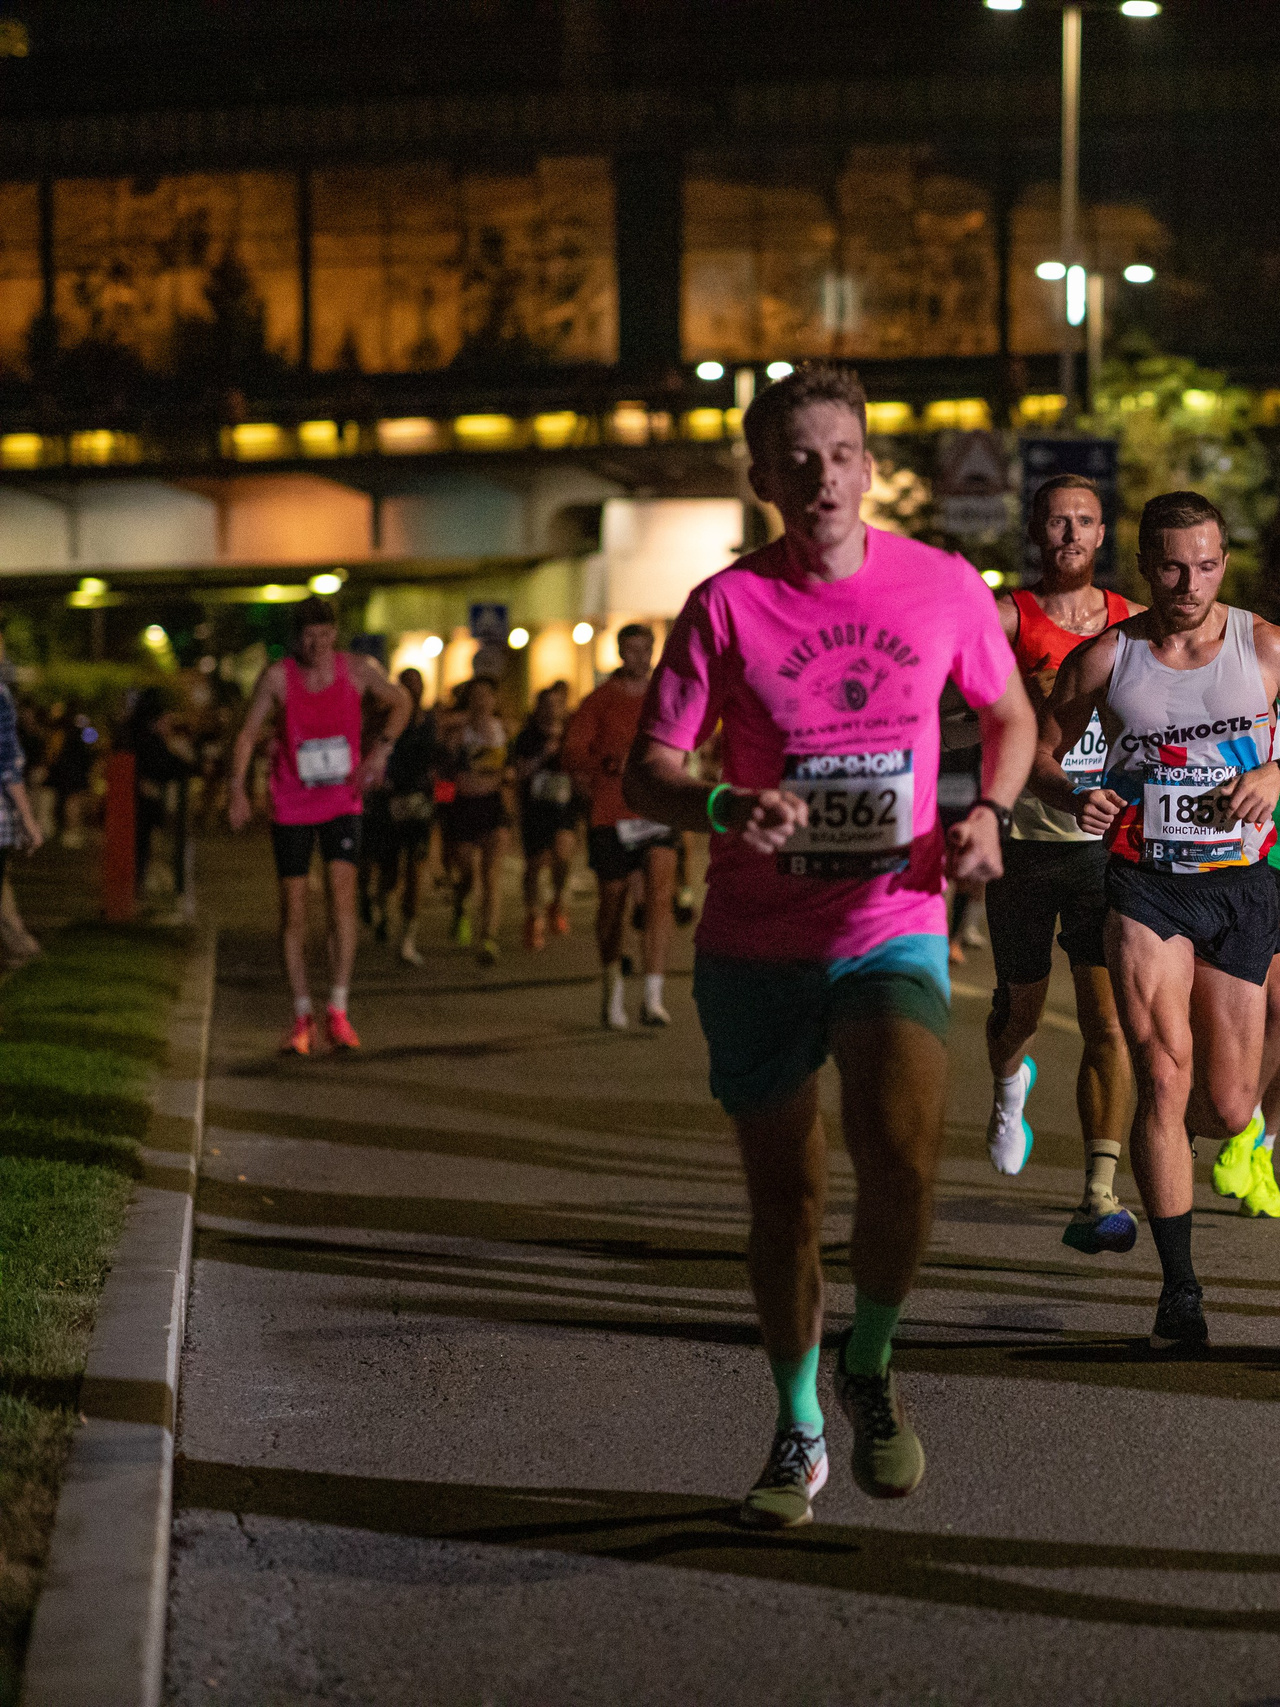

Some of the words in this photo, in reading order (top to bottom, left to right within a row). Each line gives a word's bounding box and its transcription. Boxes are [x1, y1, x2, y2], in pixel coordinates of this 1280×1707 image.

[778, 638, 818, 681] NIKE
[818, 624, 868, 651] BODY
[873, 629, 920, 668] SHOP
[1064, 756, 1103, 767] ДМИТРИЙ
